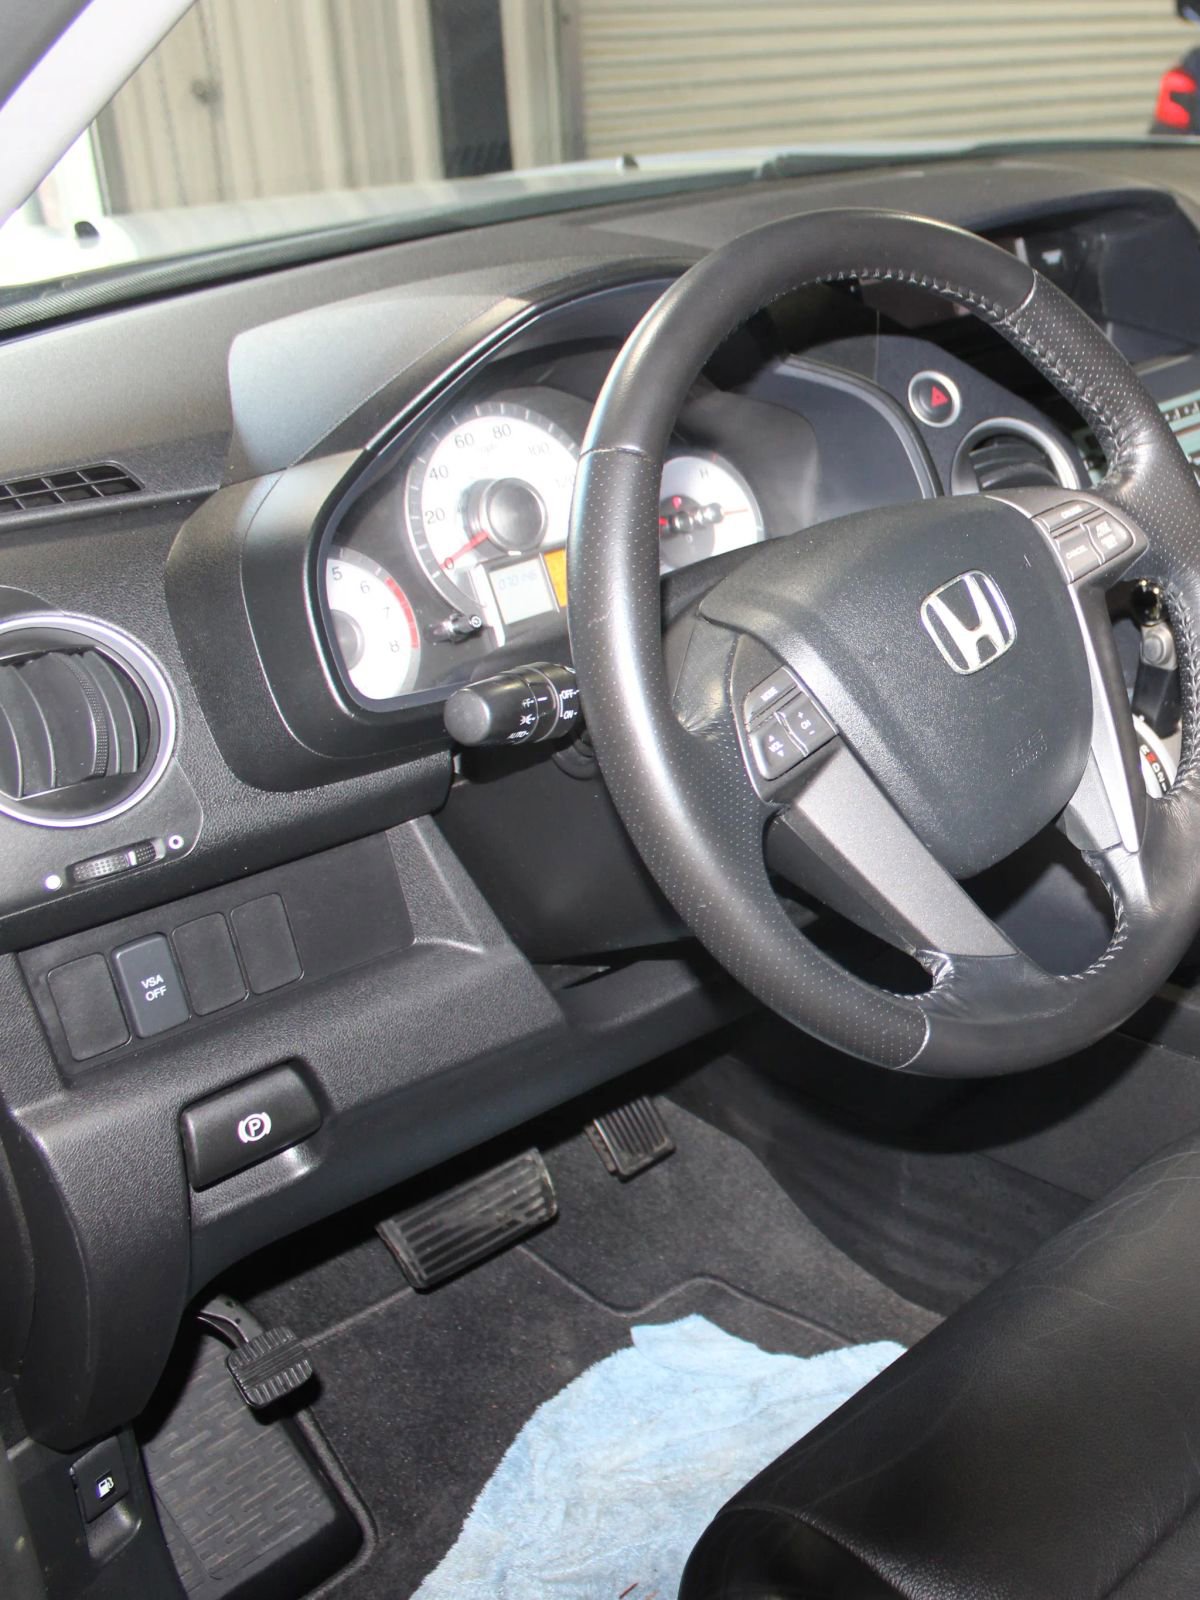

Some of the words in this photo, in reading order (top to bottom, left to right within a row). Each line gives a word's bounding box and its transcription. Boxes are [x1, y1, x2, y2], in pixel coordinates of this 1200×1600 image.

[492, 423, 513, 440] 80
[454, 432, 475, 449] 60
[428, 464, 449, 481] 40
[424, 507, 446, 525] 20
[331, 566, 343, 581] 5
[360, 580, 371, 594] 6
[383, 606, 391, 619] 7
[389, 639, 401, 654] 8
[561, 688, 574, 699] OFF
[563, 711, 573, 719] ON
[140, 974, 164, 989] VSA
[145, 985, 167, 1001] OFF
